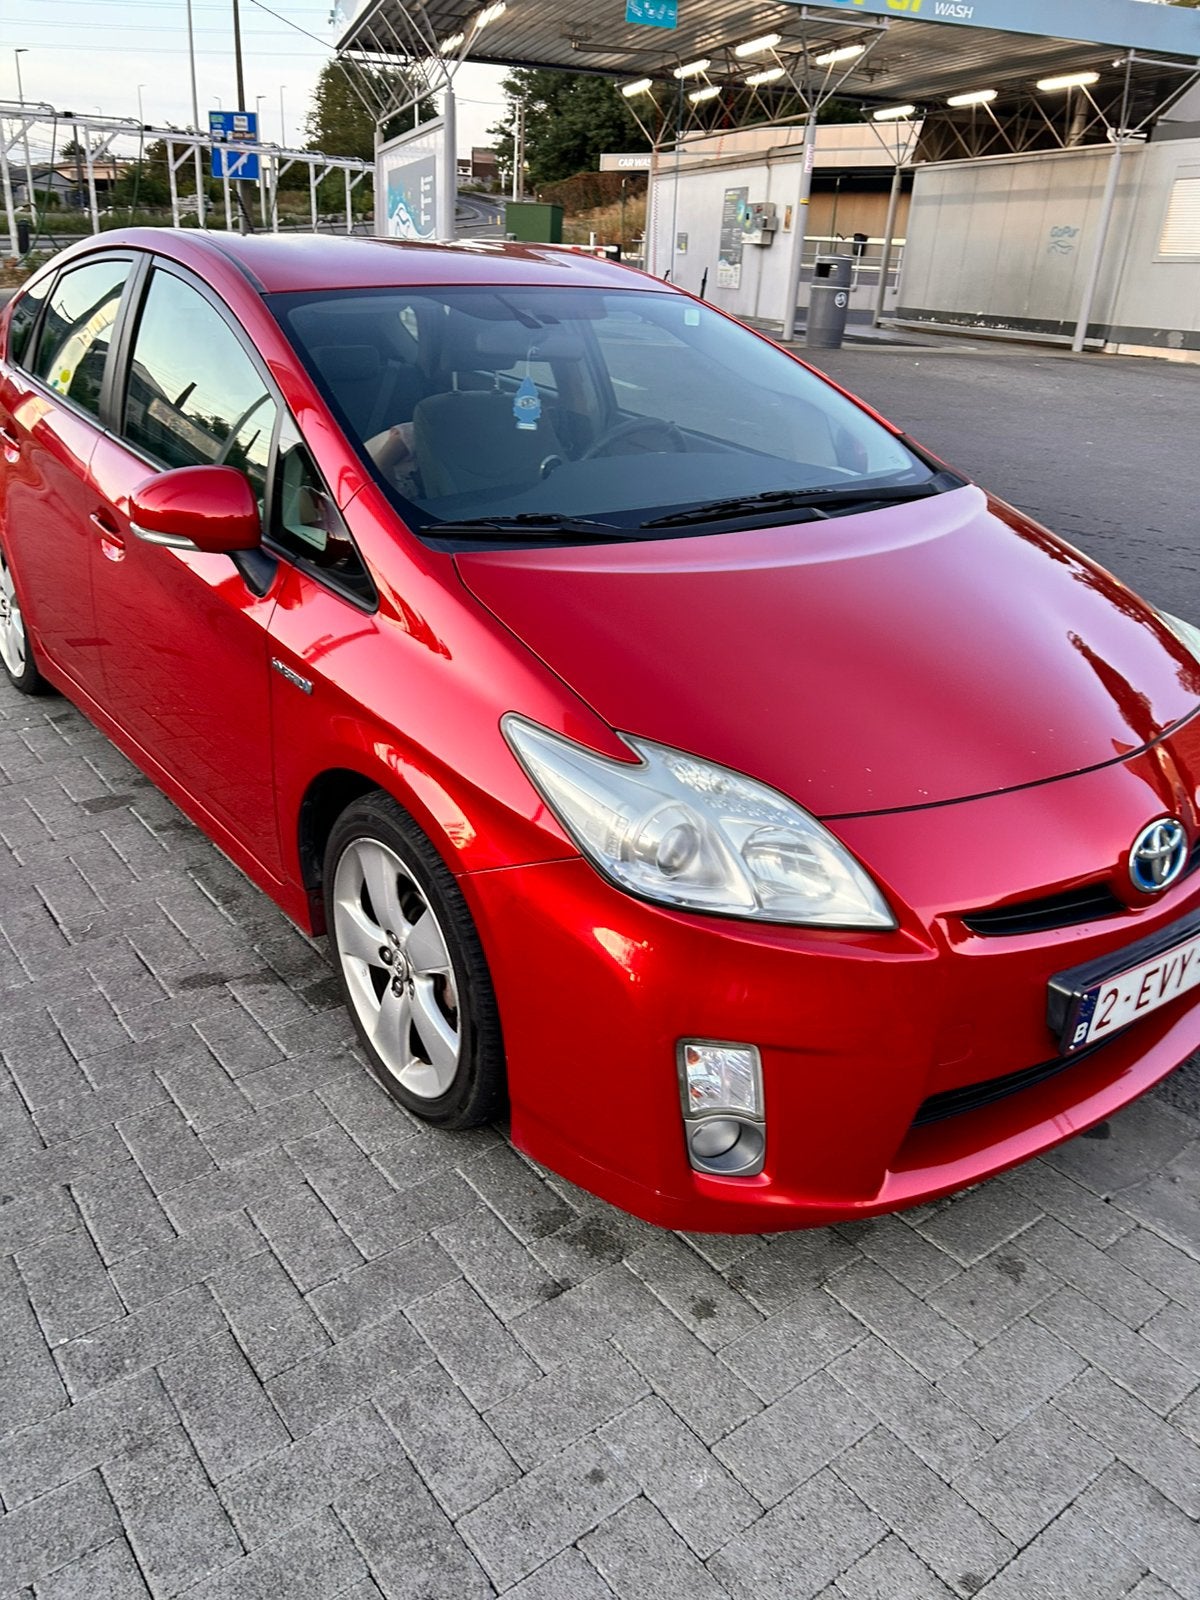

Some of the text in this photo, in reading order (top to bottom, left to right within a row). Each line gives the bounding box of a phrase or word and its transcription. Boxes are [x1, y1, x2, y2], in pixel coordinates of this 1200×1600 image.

[935, 2, 974, 18] WASH
[618, 158, 651, 167] CAR WAS
[1073, 1022, 1088, 1043] B
